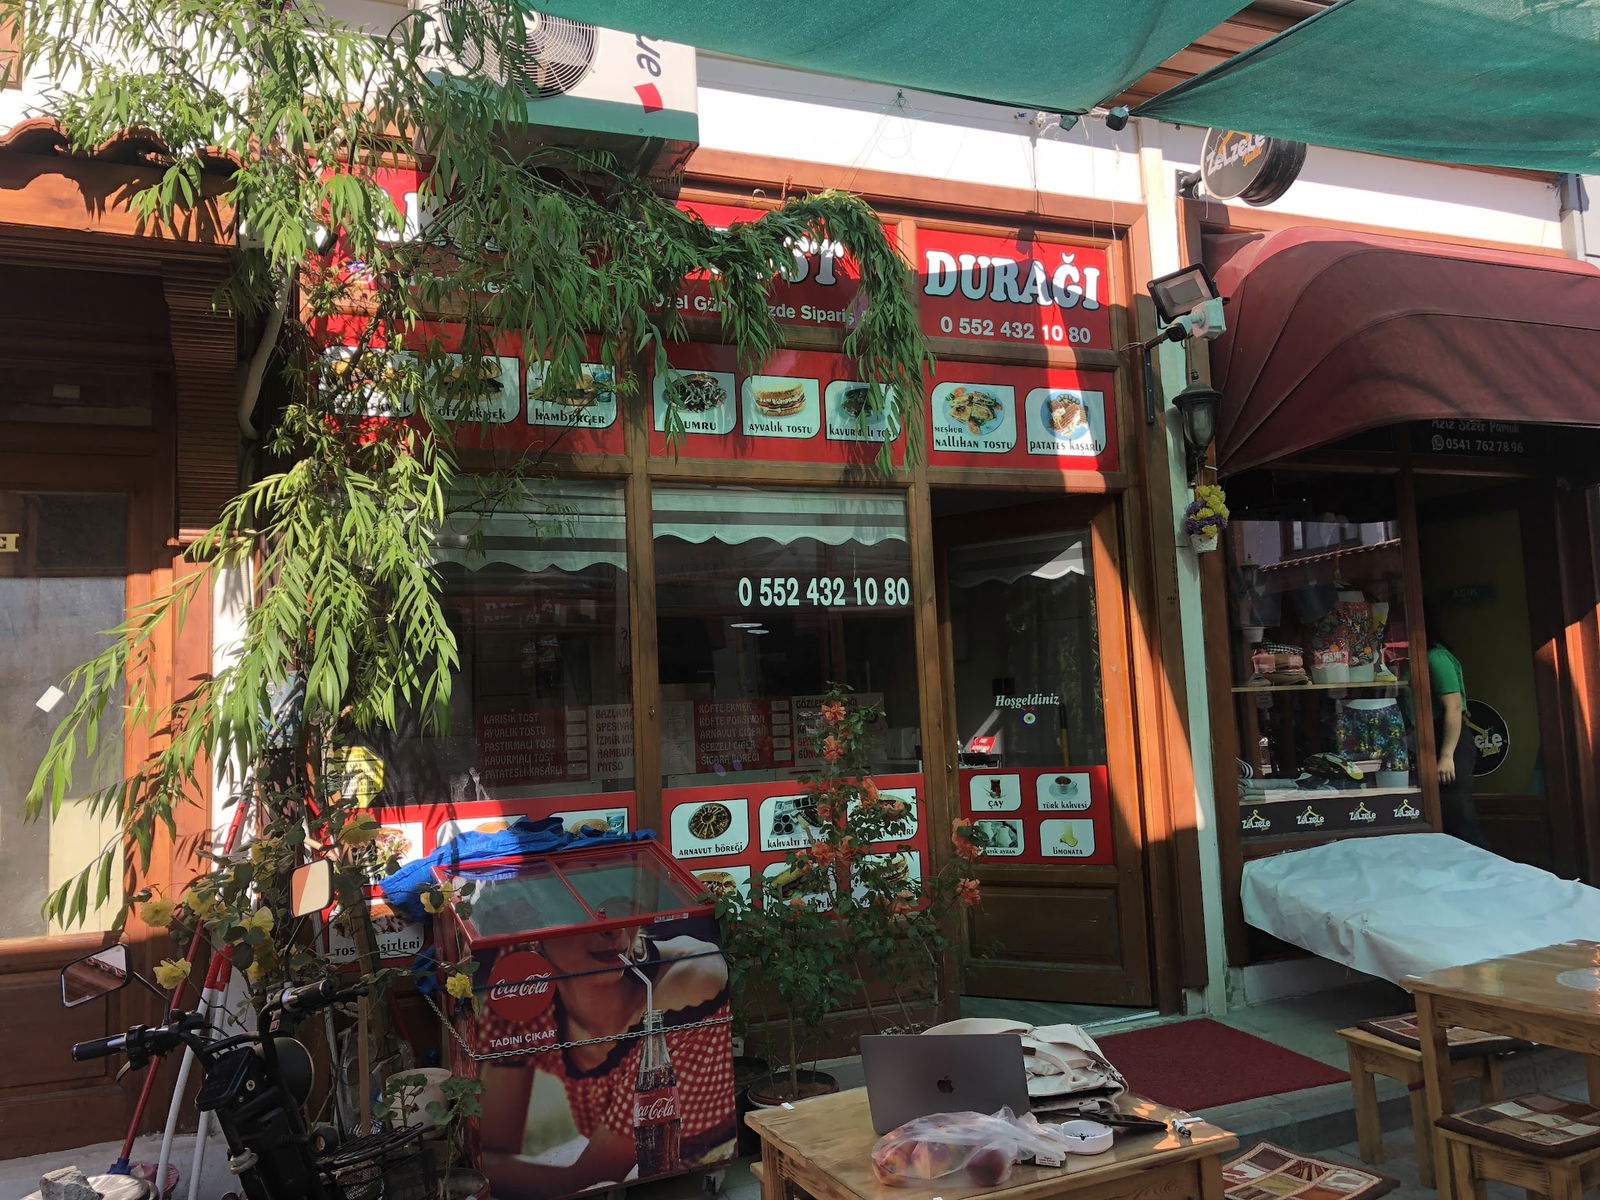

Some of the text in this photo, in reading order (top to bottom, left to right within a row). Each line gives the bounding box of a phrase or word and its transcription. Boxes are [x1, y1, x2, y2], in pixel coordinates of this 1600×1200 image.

[923, 250, 1101, 312] DURAĞI
[940, 316, 1092, 344] 0 552 432 10 80
[673, 420, 717, 431] UMRU
[786, 425, 813, 434] TOSTU
[984, 441, 1013, 450] TOSTU
[1030, 440, 1065, 452] PATATES
[1446, 438, 1472, 450] 0541
[738, 577, 910, 607] 0 552 432 10 80
[995, 692, 1060, 710] Hoşgeldiniz
[988, 800, 1004, 810] ÇAY
[1042, 801, 1059, 810] TÜRK
[678, 842, 745, 856] ARNAVUT BÖREĞİ
[335, 946, 357, 957] TOS
[490, 1030, 556, 1048] TADINI ÇIKAR
